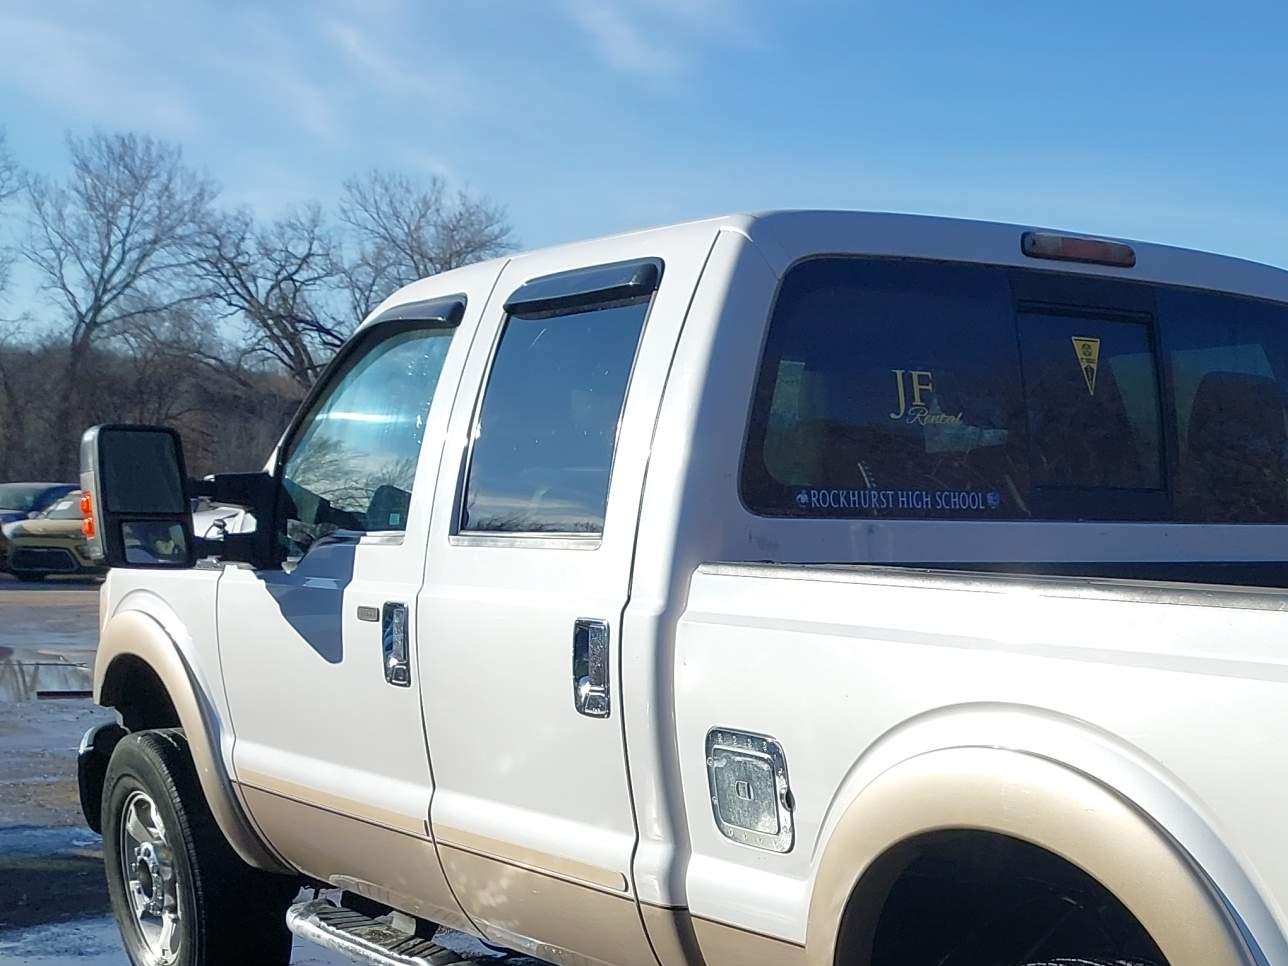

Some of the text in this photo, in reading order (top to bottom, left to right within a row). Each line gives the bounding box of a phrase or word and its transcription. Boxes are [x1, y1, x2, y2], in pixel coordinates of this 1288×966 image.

[889, 369, 933, 419] JF
[810, 489, 985, 510] ROCKHURST HIGH SCHOOL
